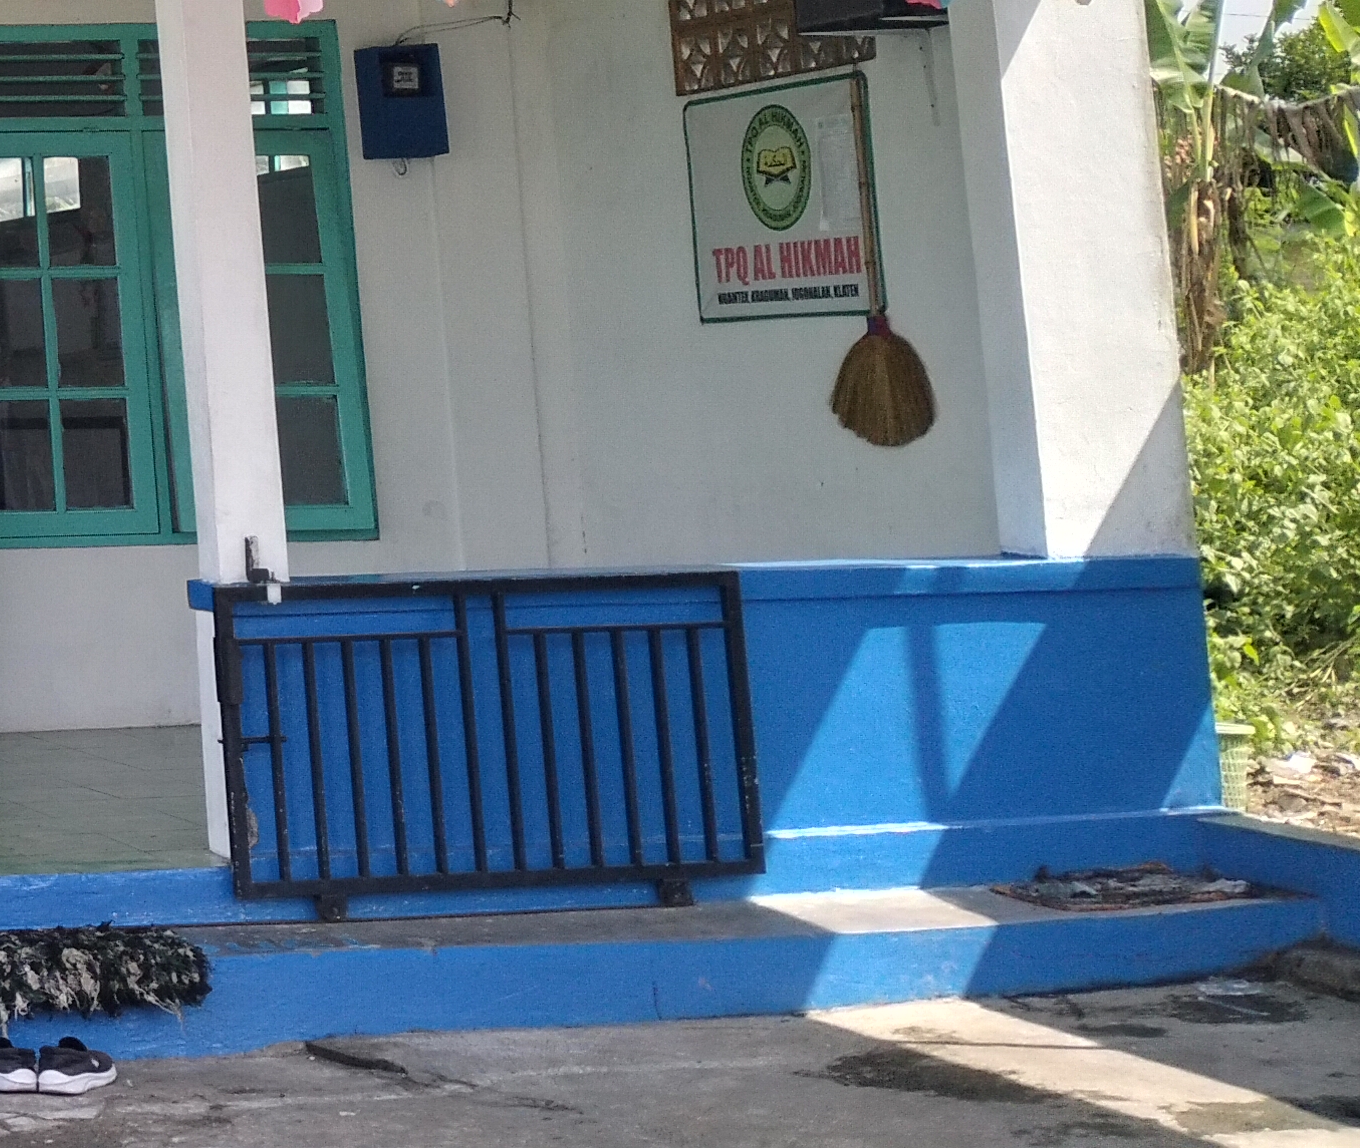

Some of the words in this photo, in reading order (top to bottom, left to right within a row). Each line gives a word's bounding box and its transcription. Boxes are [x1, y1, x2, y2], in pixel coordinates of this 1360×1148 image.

[712, 245, 750, 286] TPQ
[753, 243, 777, 282] AL
[778, 235, 862, 279] HIKMAH
